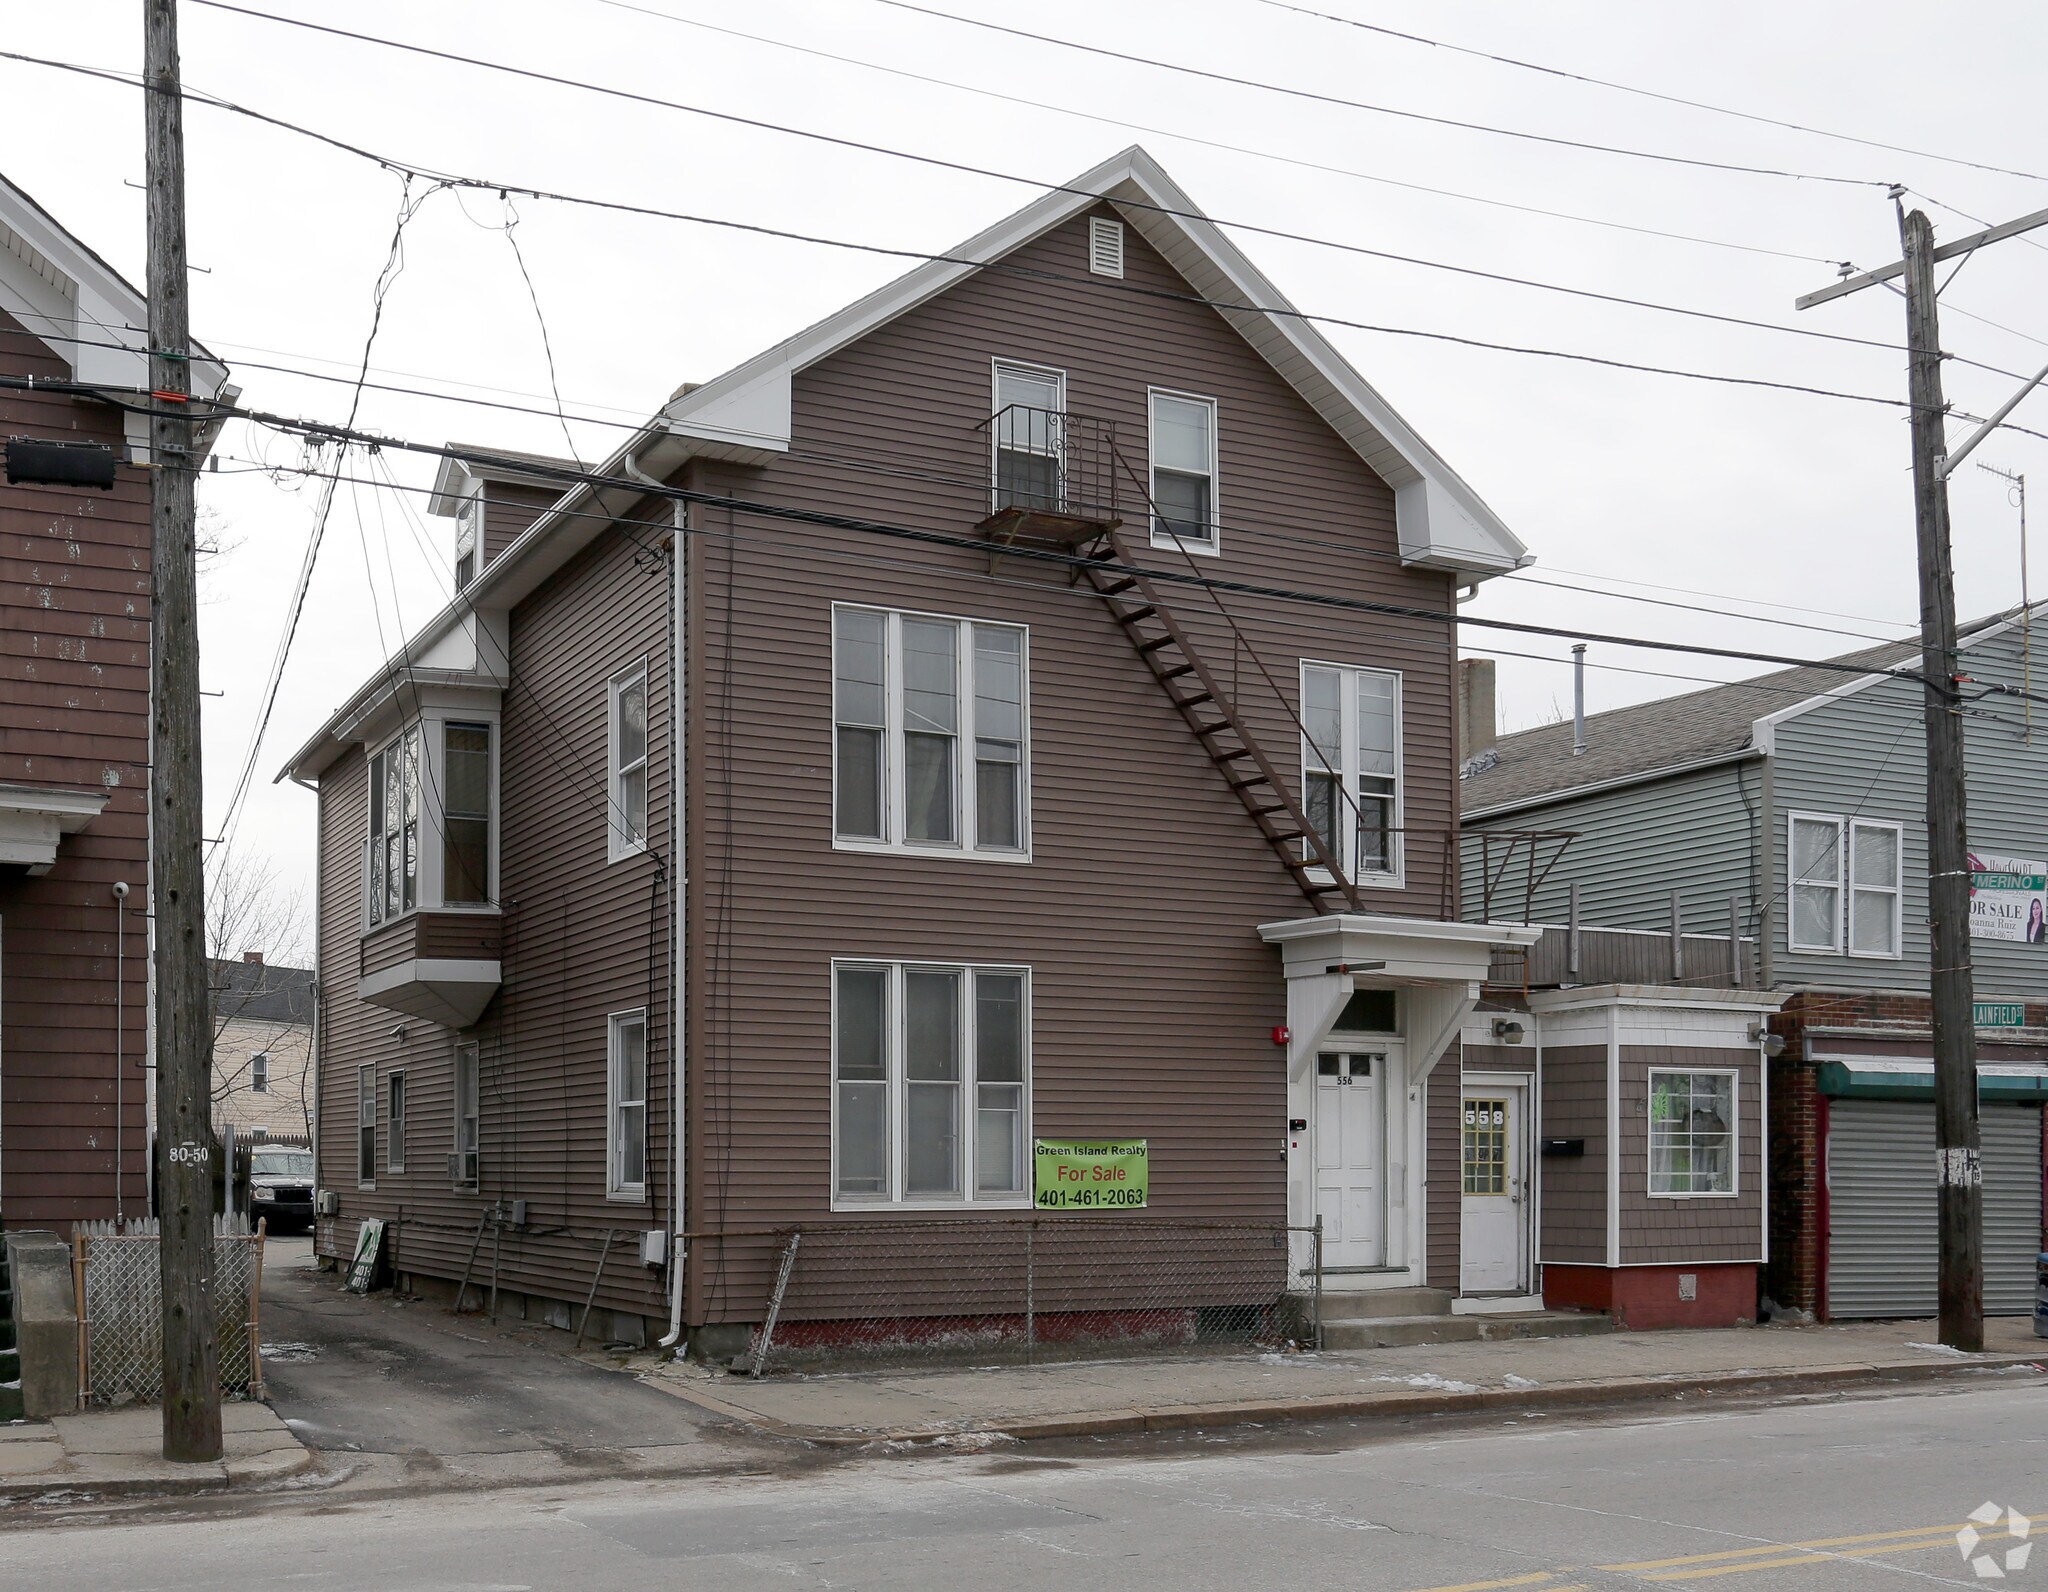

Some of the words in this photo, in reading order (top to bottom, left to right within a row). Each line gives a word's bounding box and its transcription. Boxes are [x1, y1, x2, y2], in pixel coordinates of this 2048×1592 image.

[1976, 875, 2032, 889] MERINO
[2037, 876, 2045, 884] ST
[1968, 900, 1986, 915] OR
[1989, 902, 2023, 919] SALE
[1969, 919, 1995, 928] oanna
[1997, 918, 2017, 930] Ruiz
[1969, 928, 2014, 940] 01-300-8675
[1973, 1006, 2017, 1025] LAINFIELD
[2016, 1006, 2023, 1017] ST
[1337, 1076, 1352, 1085] 556
[1465, 1110, 1504, 1125] 558
[169, 1147, 208, 1162] 80-50
[1036, 1145, 1071, 1156] Green
[1074, 1146, 1108, 1156] Island
[1111, 1145, 1146, 1157] Realty
[1057, 1165, 1087, 1182] For
[1092, 1165, 1127, 1182] Sale
[1038, 1188, 1143, 1206] 401-461-2063
